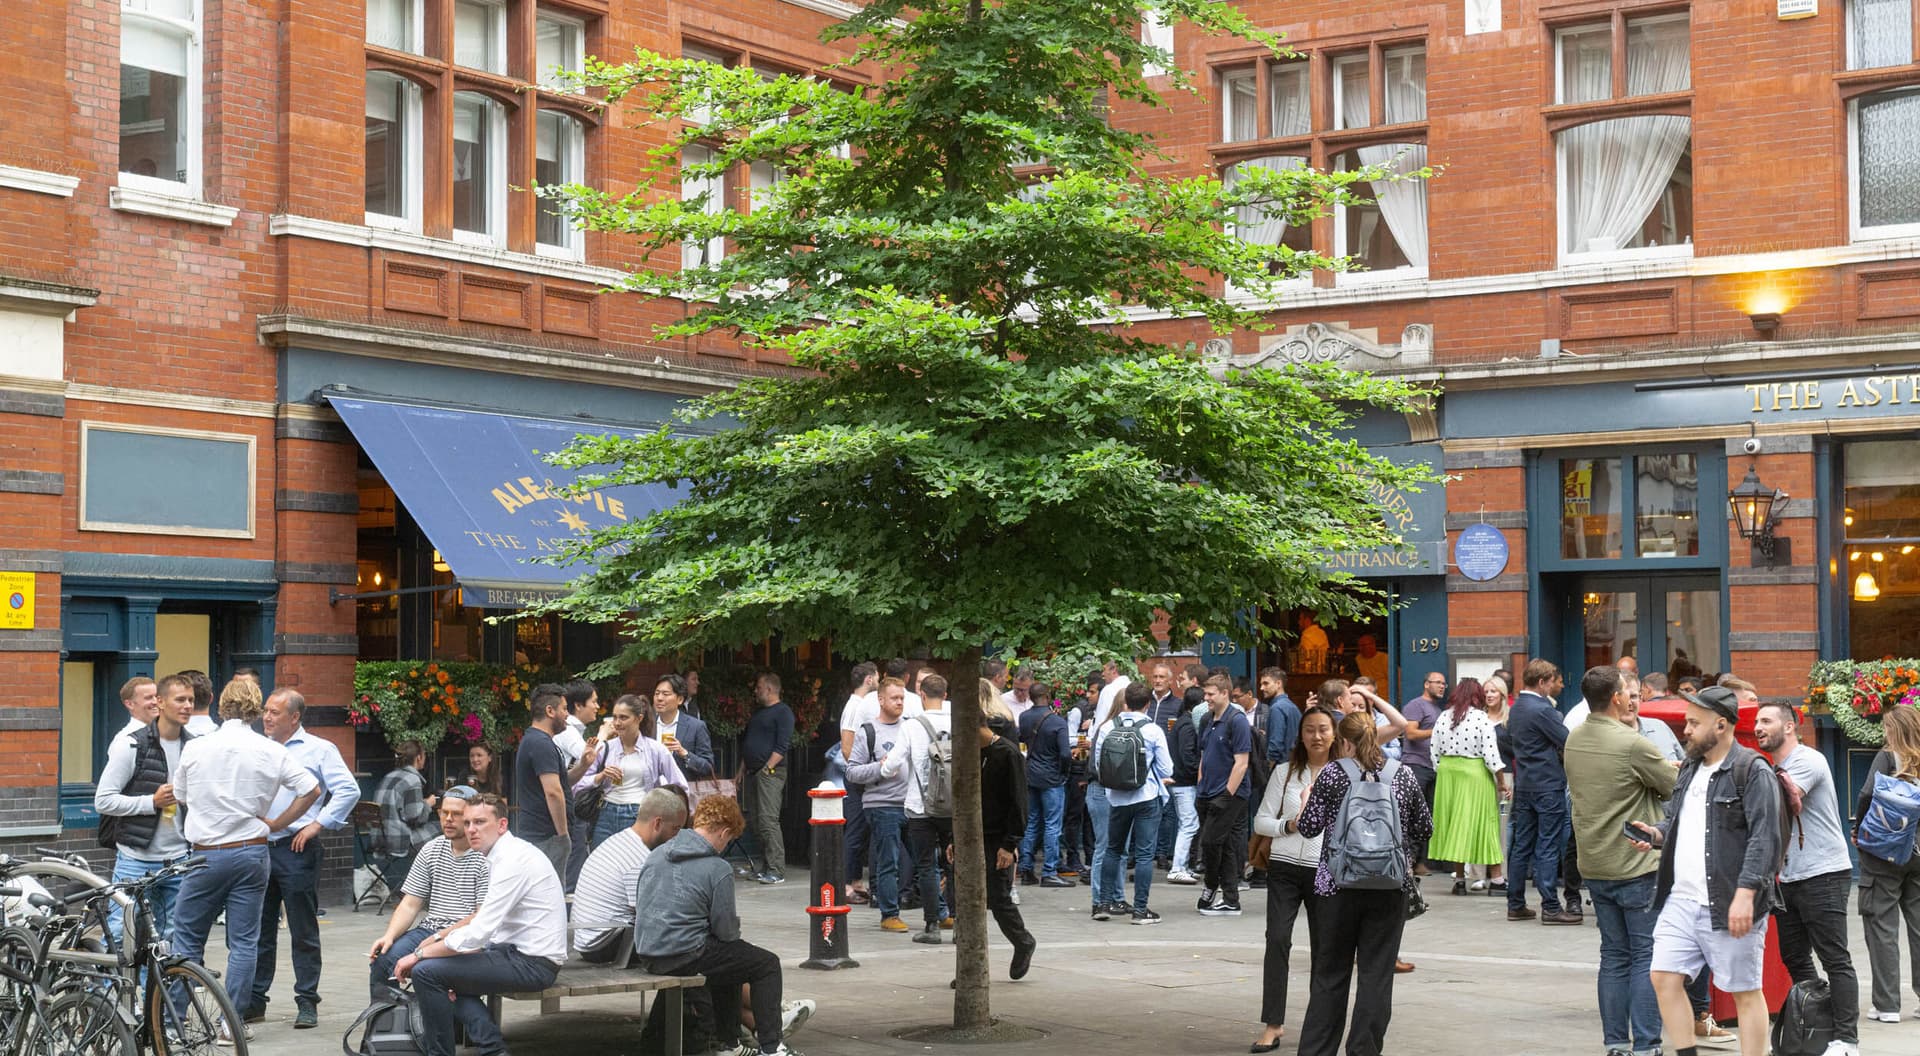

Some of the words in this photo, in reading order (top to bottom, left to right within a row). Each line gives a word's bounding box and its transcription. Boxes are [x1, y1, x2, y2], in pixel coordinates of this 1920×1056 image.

[1745, 380, 1823, 412] THE
[490, 476, 550, 515] ALE
[464, 530, 527, 550] THE
[1325, 551, 1420, 569] ENTRANCE
[488, 589, 559, 606] BREAKFAST
[1210, 641, 1236, 655] 125
[1411, 637, 1440, 653] 129
